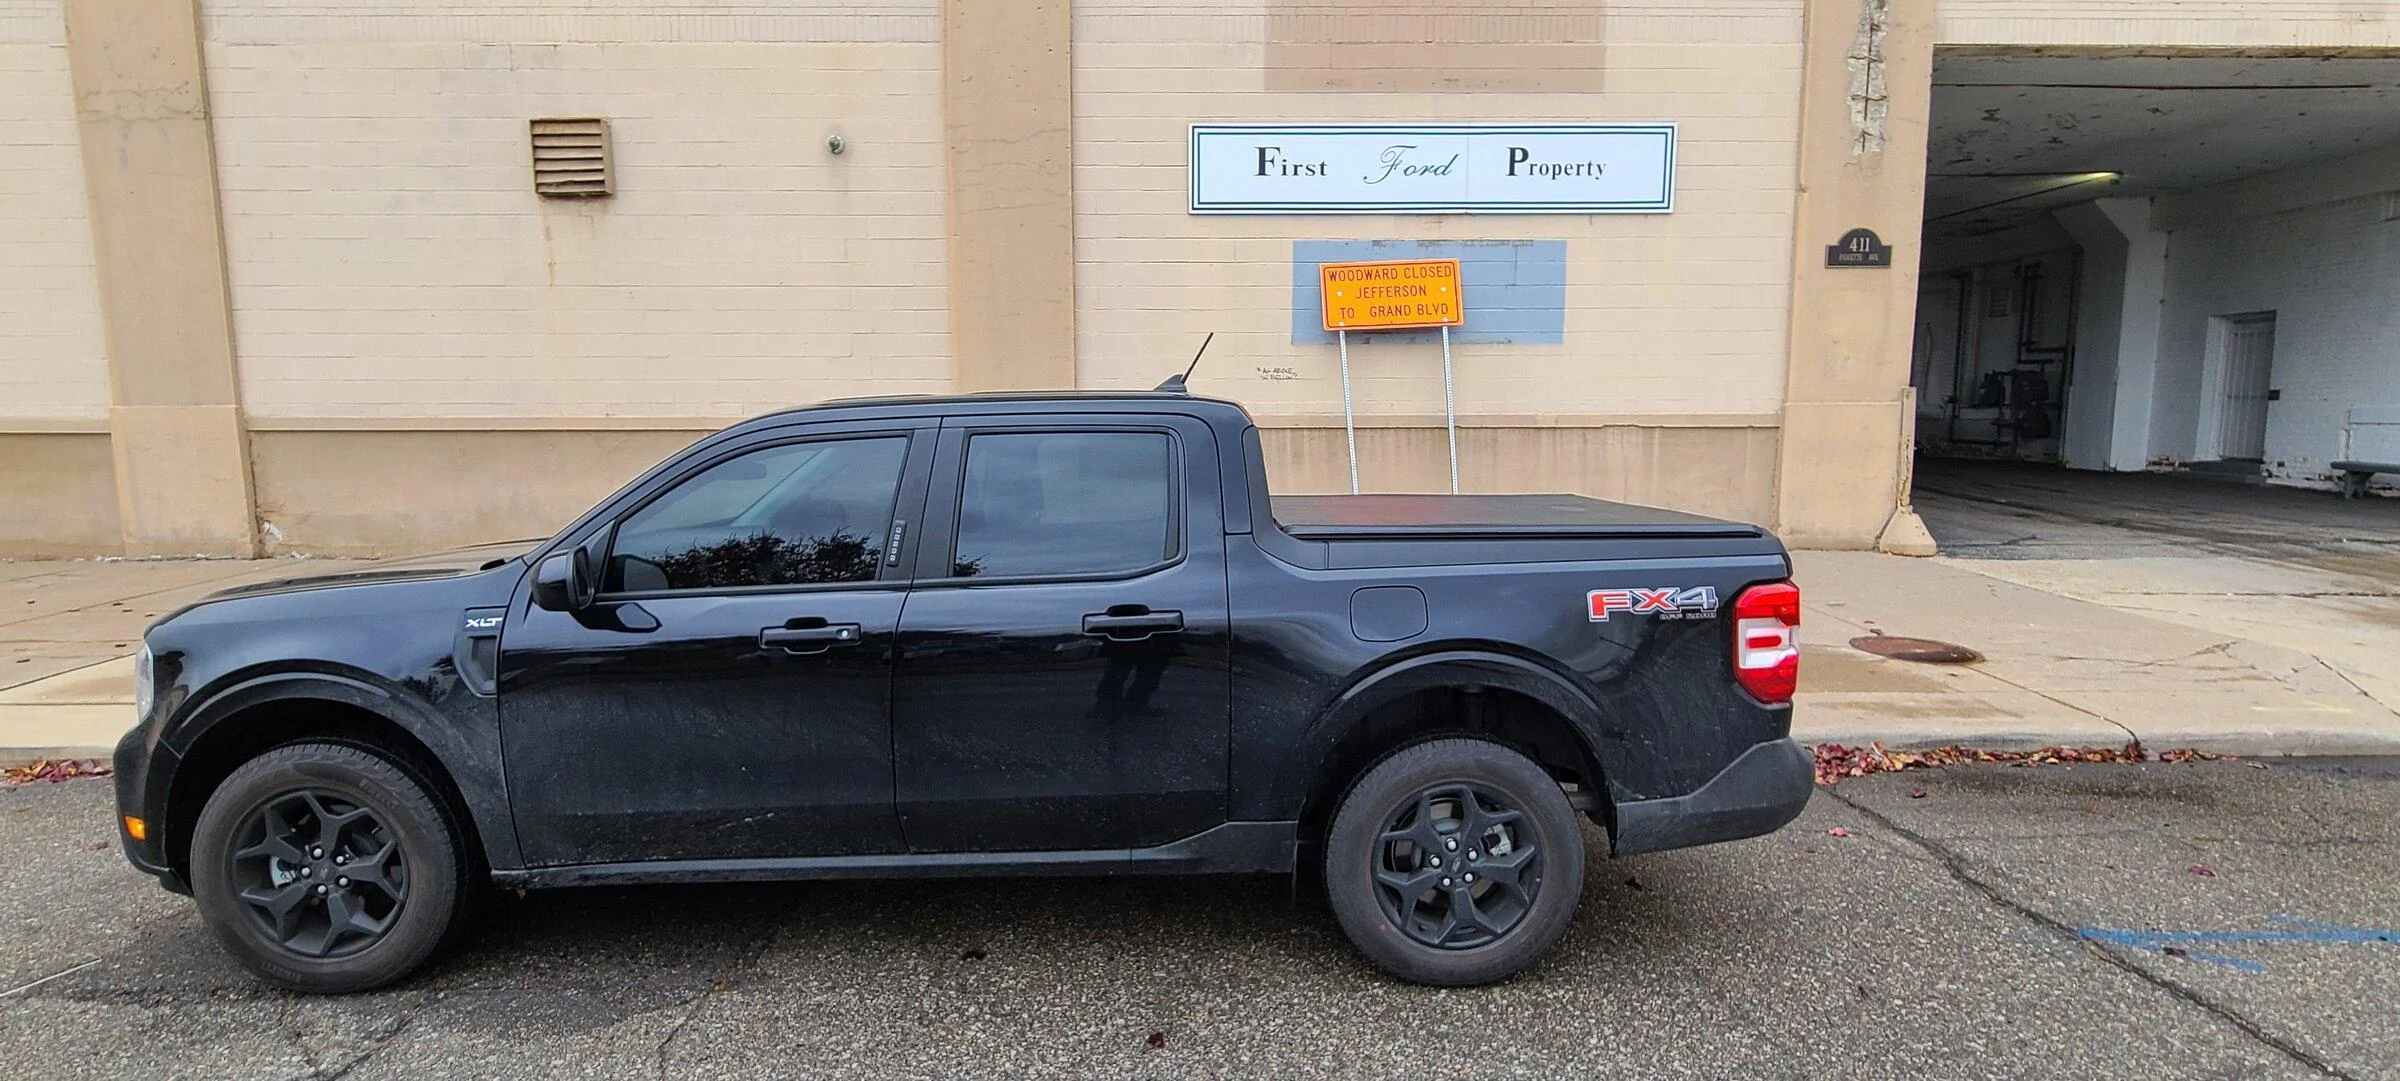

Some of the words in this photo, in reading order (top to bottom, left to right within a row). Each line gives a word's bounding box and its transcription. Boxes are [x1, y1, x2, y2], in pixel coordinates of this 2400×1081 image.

[1254, 146, 1328, 177] First
[1363, 145, 1459, 185] Ford
[1506, 146, 1606, 180] Property
[1849, 237, 1870, 252] 411
[1328, 268, 1398, 282] WOODWARD
[1403, 266, 1451, 279] CLOSED
[1356, 285, 1427, 299] JEFFERSON
[1340, 307, 1355, 319] TO
[1370, 304, 1411, 318] GRAND
[1417, 303, 1448, 316] BLVD
[1587, 586, 1719, 622] FX4
[465, 617, 503, 628] XLT
